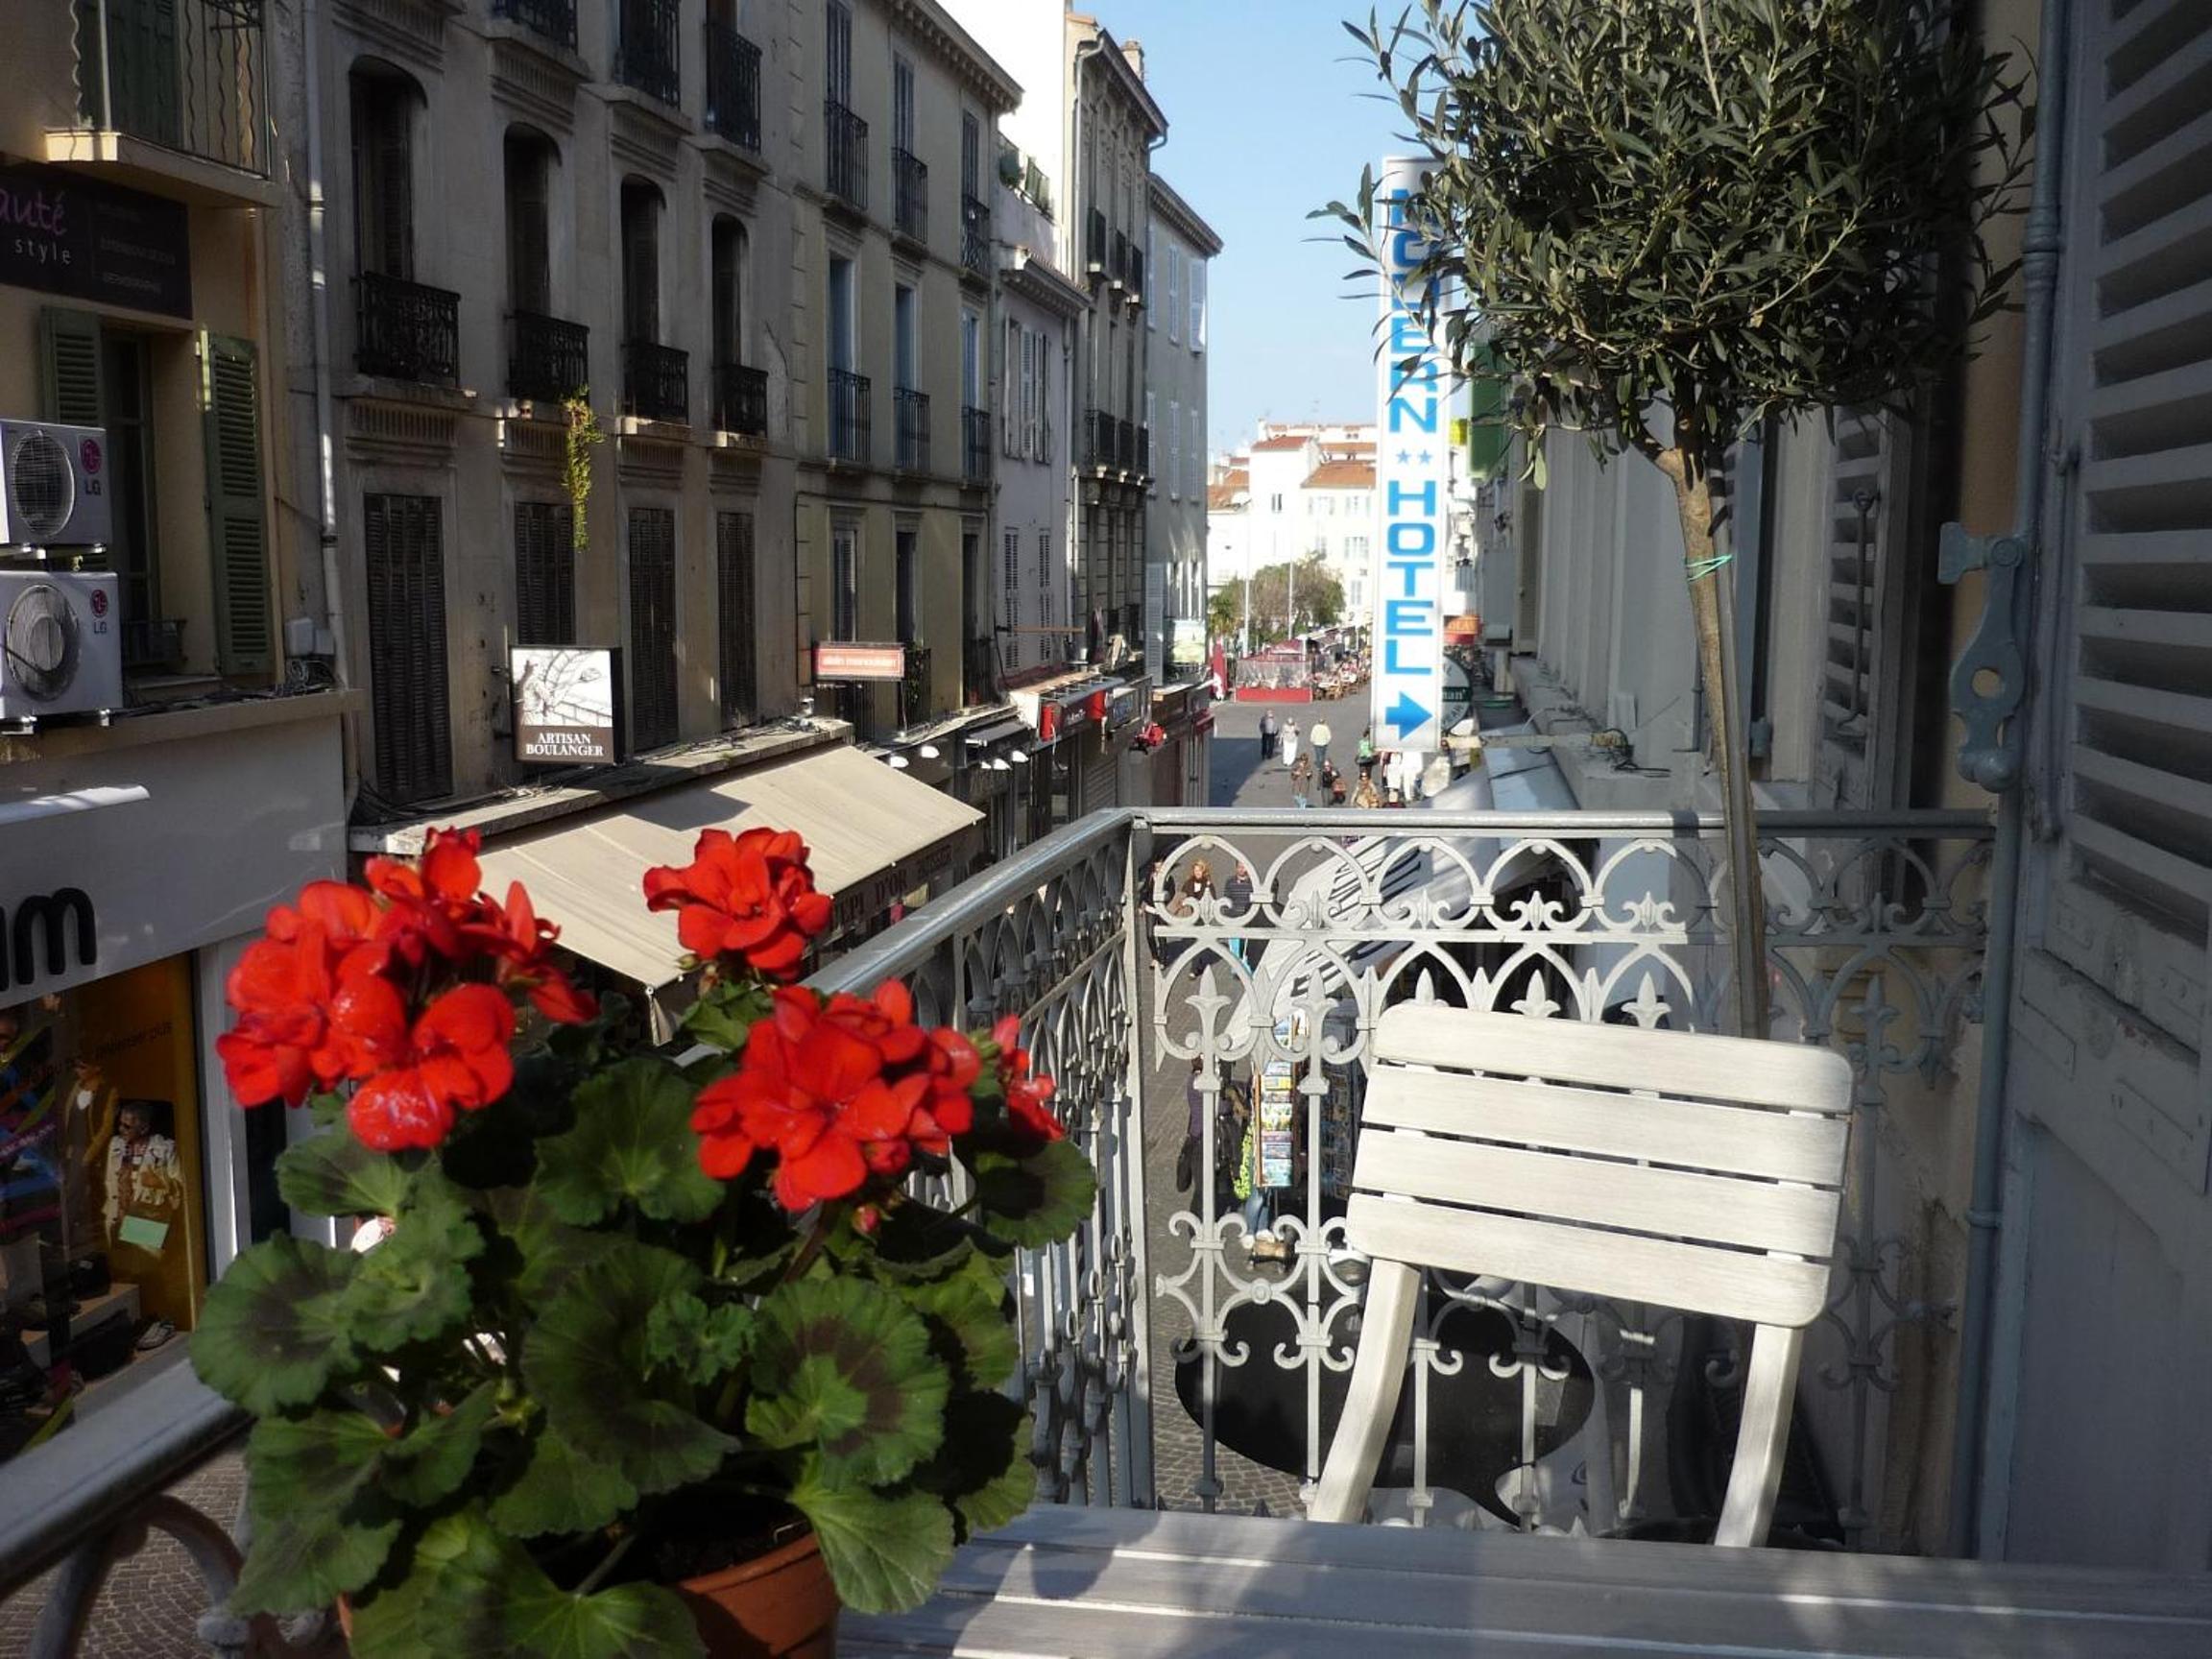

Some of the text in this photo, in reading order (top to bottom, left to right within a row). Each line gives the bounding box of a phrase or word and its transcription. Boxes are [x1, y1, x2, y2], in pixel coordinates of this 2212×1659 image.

[14, 237, 72, 265] style
[84, 479, 102, 496] LG
[1384, 480, 1437, 675] HOTEL
[93, 620, 108, 635] LG
[537, 732, 591, 745] ARTISAN
[525, 743, 604, 757] BOULANGER
